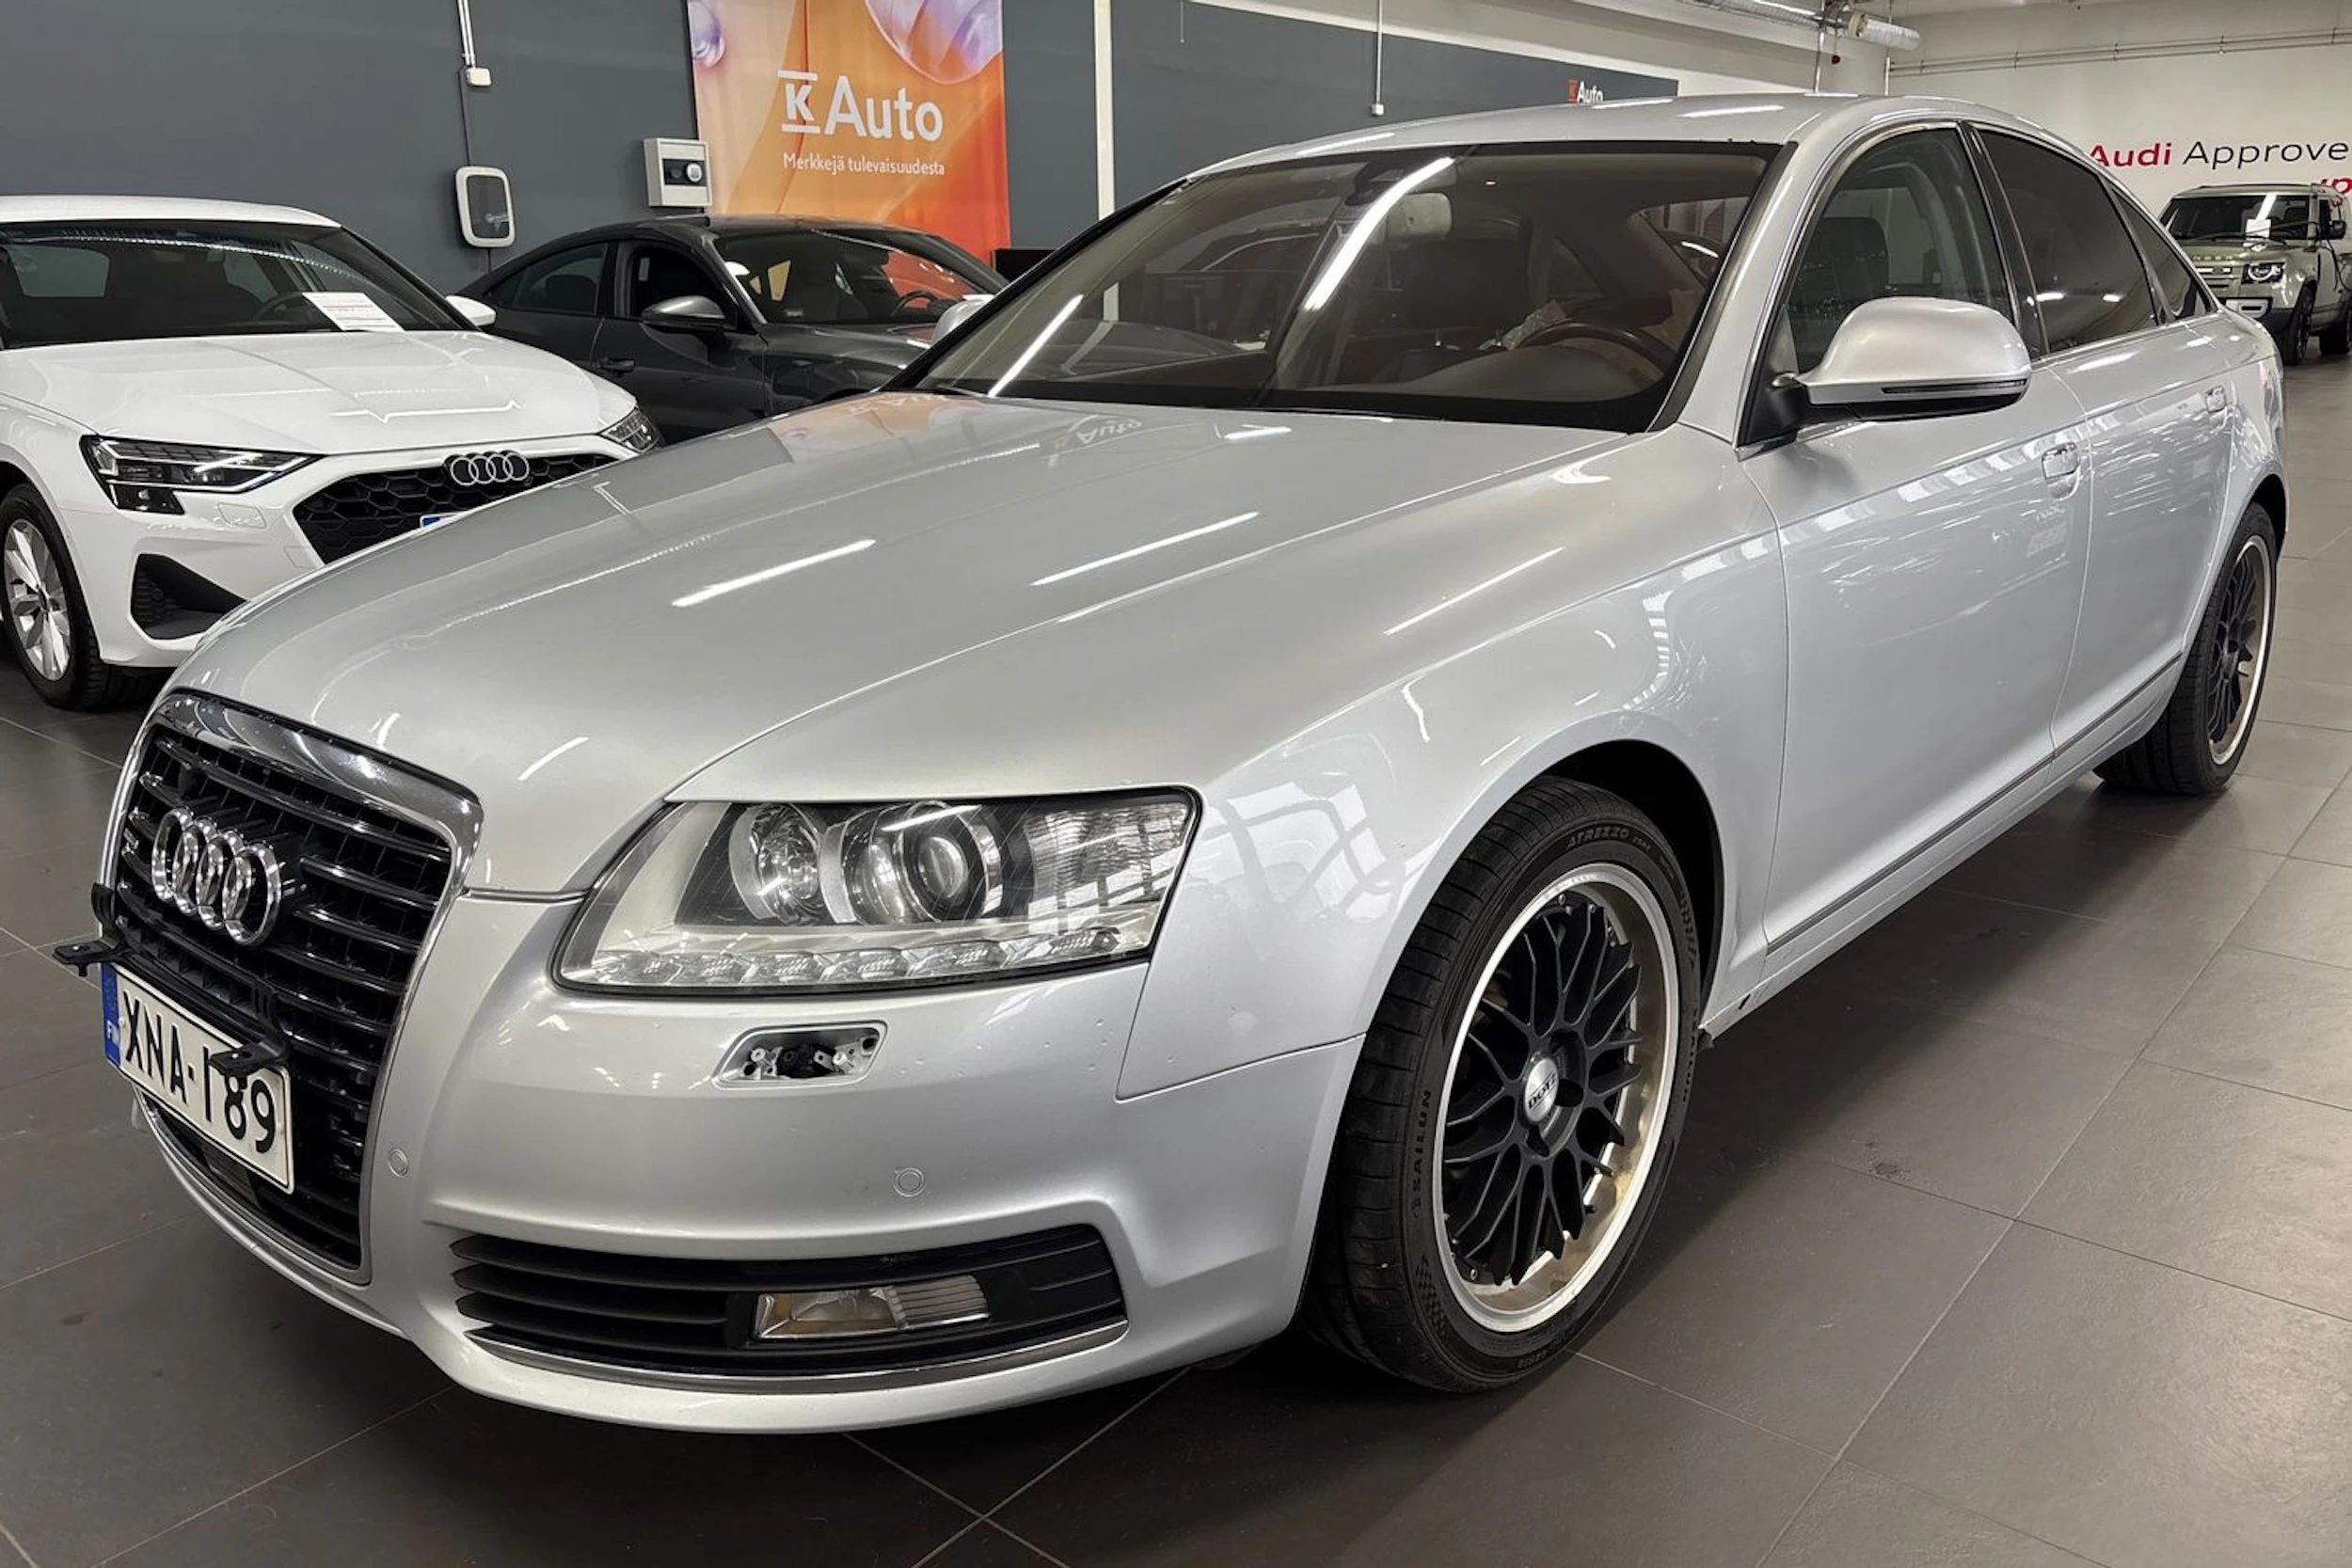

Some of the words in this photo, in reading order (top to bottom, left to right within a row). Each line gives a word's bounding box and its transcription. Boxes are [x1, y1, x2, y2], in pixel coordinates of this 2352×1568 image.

[824, 74, 944, 142] Auto
[1577, 80, 1604, 103] Auto
[783, 152, 846, 177] Merkkejä
[848, 155, 946, 176] tulevaisuudesta
[2089, 142, 2172, 167] Audi
[122, 990, 277, 1154] XNA-189
[1413, 1088, 1432, 1193] SAILUN
